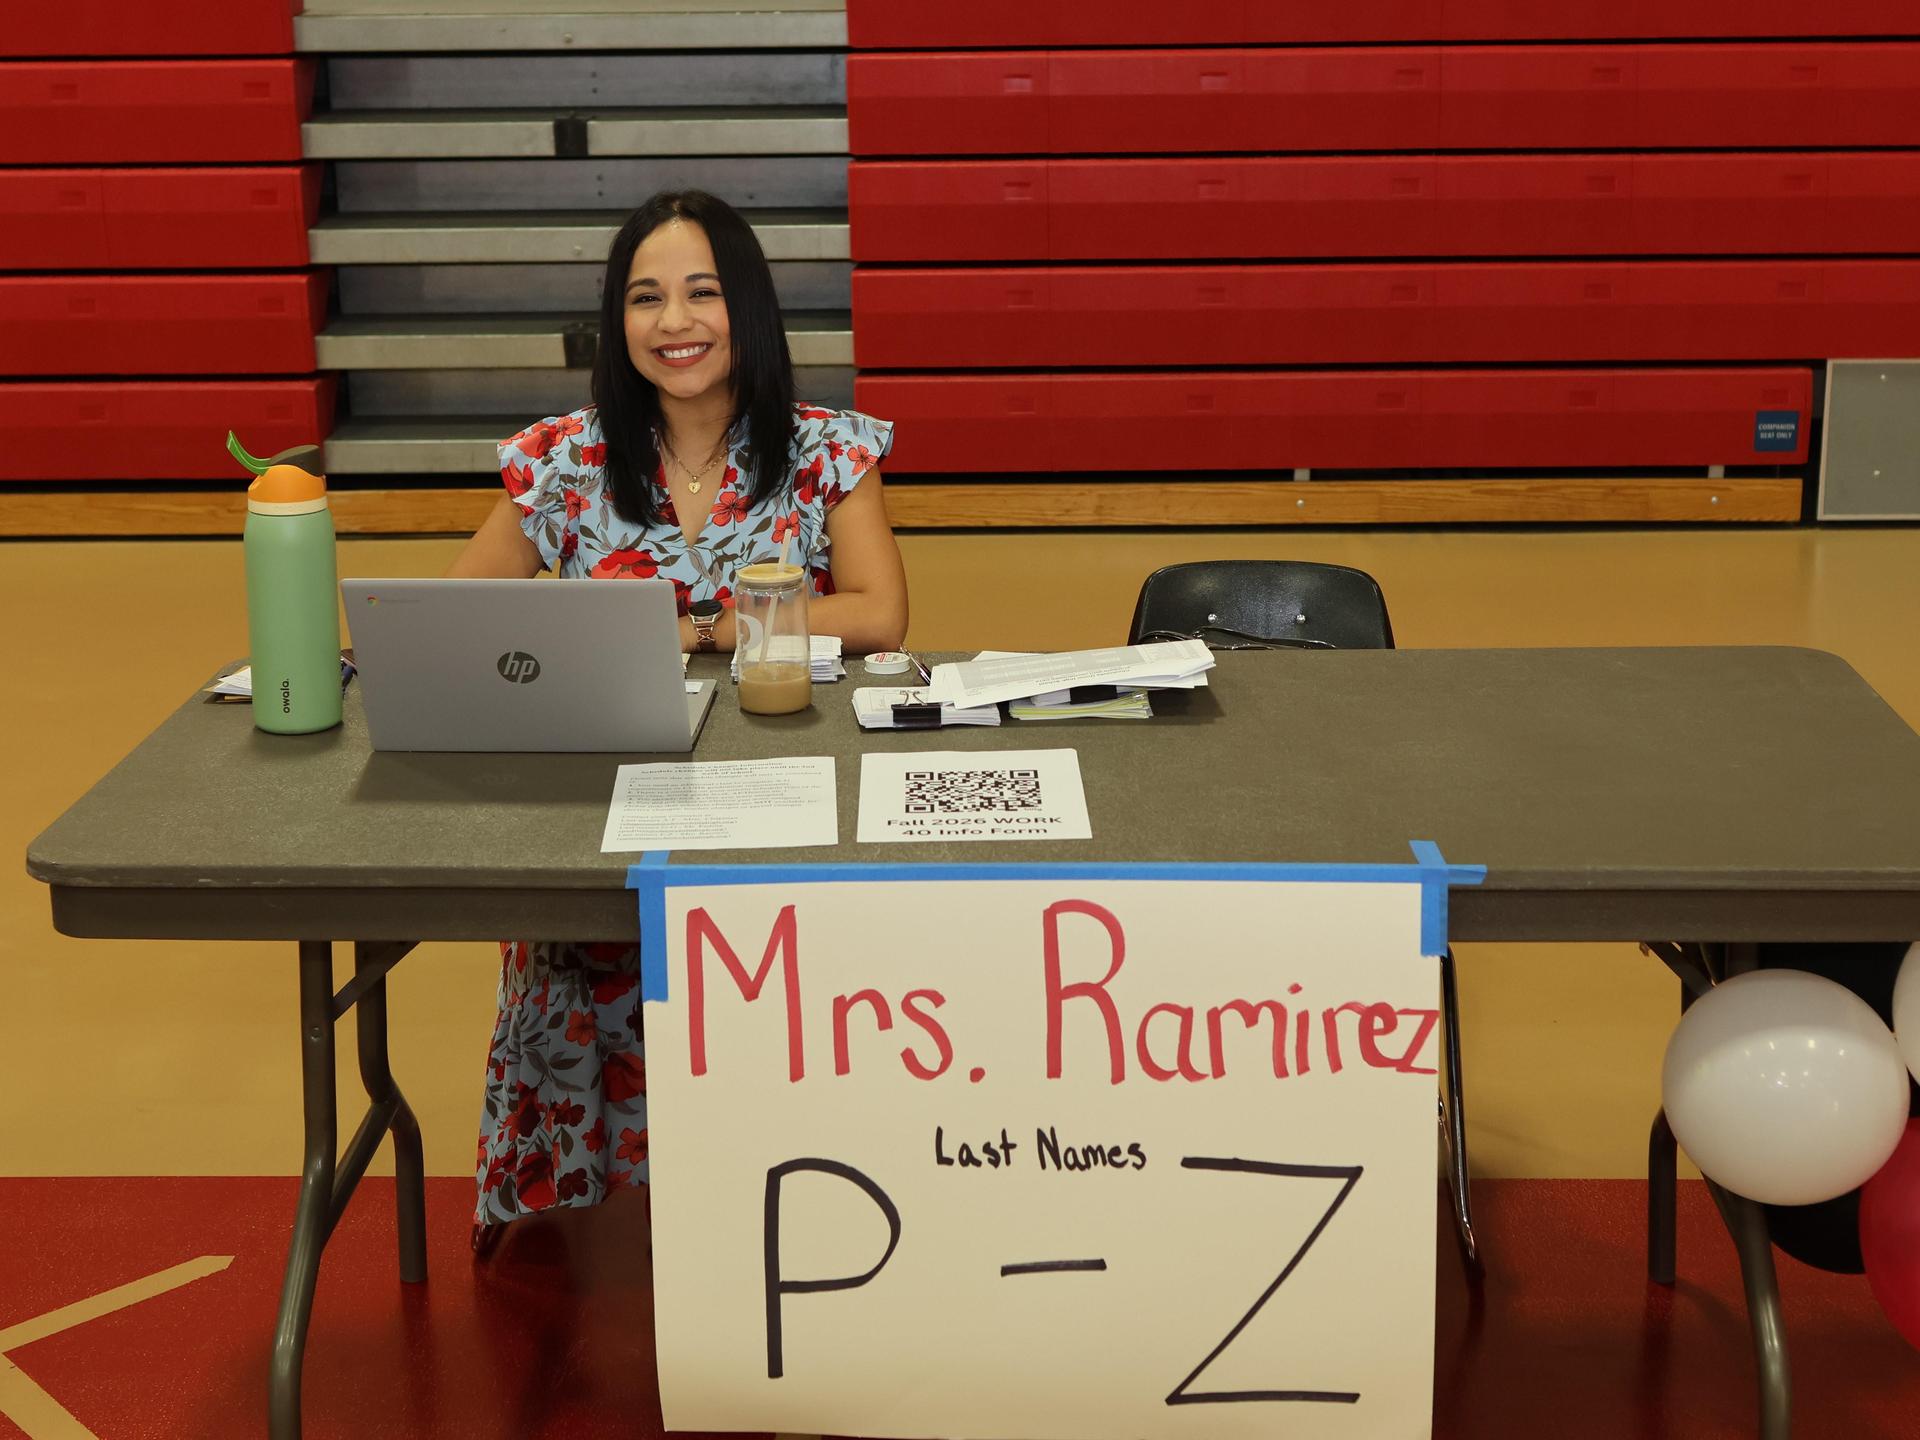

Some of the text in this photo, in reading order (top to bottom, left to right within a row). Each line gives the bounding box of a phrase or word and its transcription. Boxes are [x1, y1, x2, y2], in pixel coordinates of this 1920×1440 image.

[1776, 431, 1793, 439] ONLY
[503, 651, 536, 684] hp
[931, 817, 987, 826] 2026
[685, 899, 1439, 1086] Mrs. Ramirez
[934, 1126, 1148, 1172] Last Names
[763, 1157, 902, 1380] P
[1165, 1156, 1364, 1406] Z
